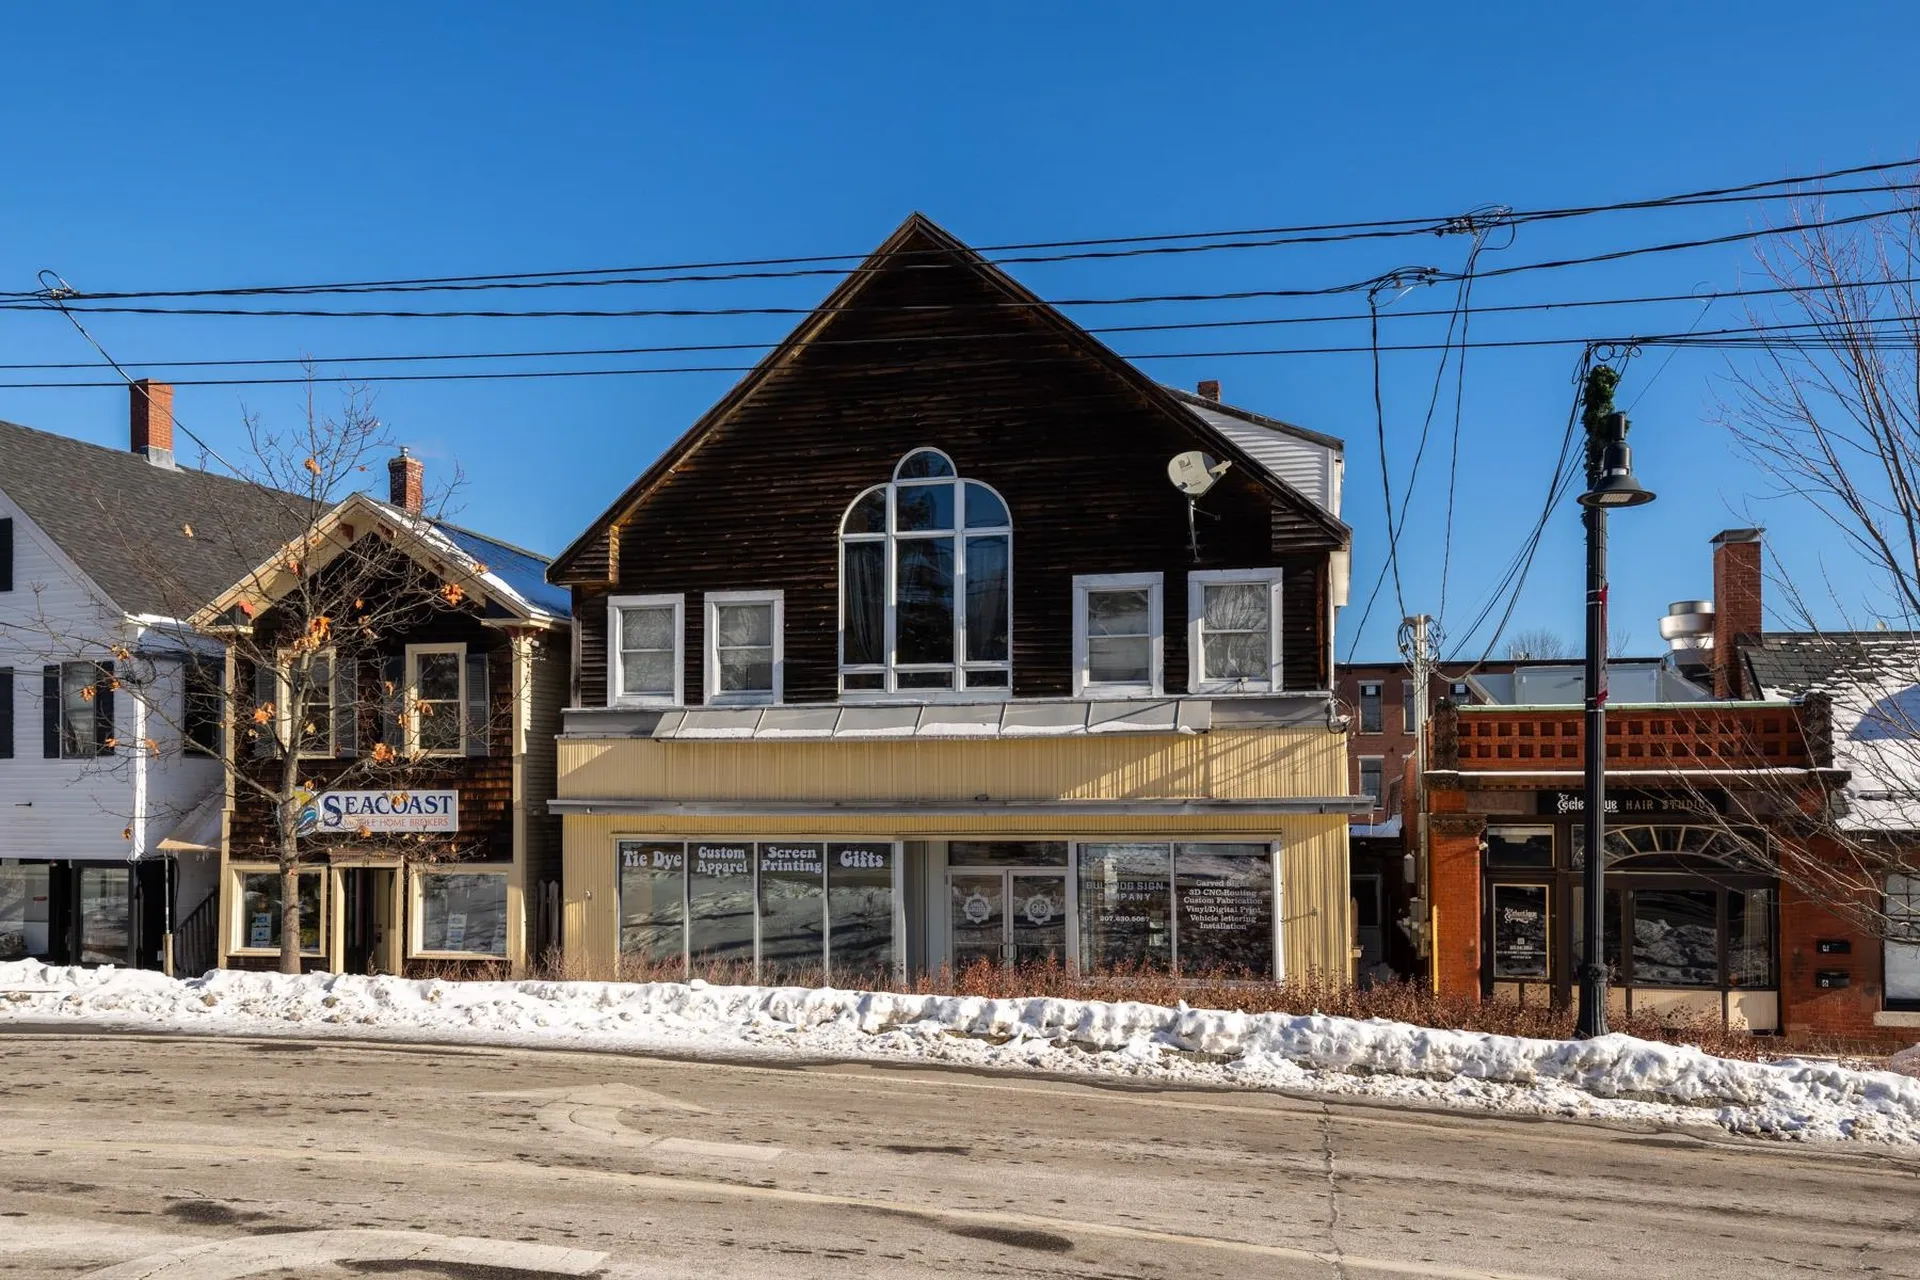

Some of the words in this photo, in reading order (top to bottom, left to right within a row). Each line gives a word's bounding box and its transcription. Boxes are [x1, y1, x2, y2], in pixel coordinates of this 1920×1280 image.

[1625, 799, 1654, 810] HAIR
[323, 795, 452, 827] SEACOAST
[380, 817, 405, 827] HOME
[409, 817, 449, 827] BROKERS
[698, 846, 746, 859] Custom
[767, 846, 817, 859] Screen
[623, 850, 648, 867] Tie
[652, 850, 682, 870] Dye
[840, 850, 884, 868] Gifts
[696, 860, 748, 875] Apparel
[760, 859, 822, 874] Printing
[1137, 881, 1164, 891] SIGN
[1195, 879, 1225, 887] Carved
[1188, 888, 1201, 896] 3D
[1202, 888, 1222, 896] CNC
[1223, 889, 1258, 899] Routing
[1183, 896, 1214, 904] Custom
[1216, 897, 1263, 905] Fabrication
[1190, 914, 1219, 922] Vehicle
[1199, 922, 1247, 930] Installation
